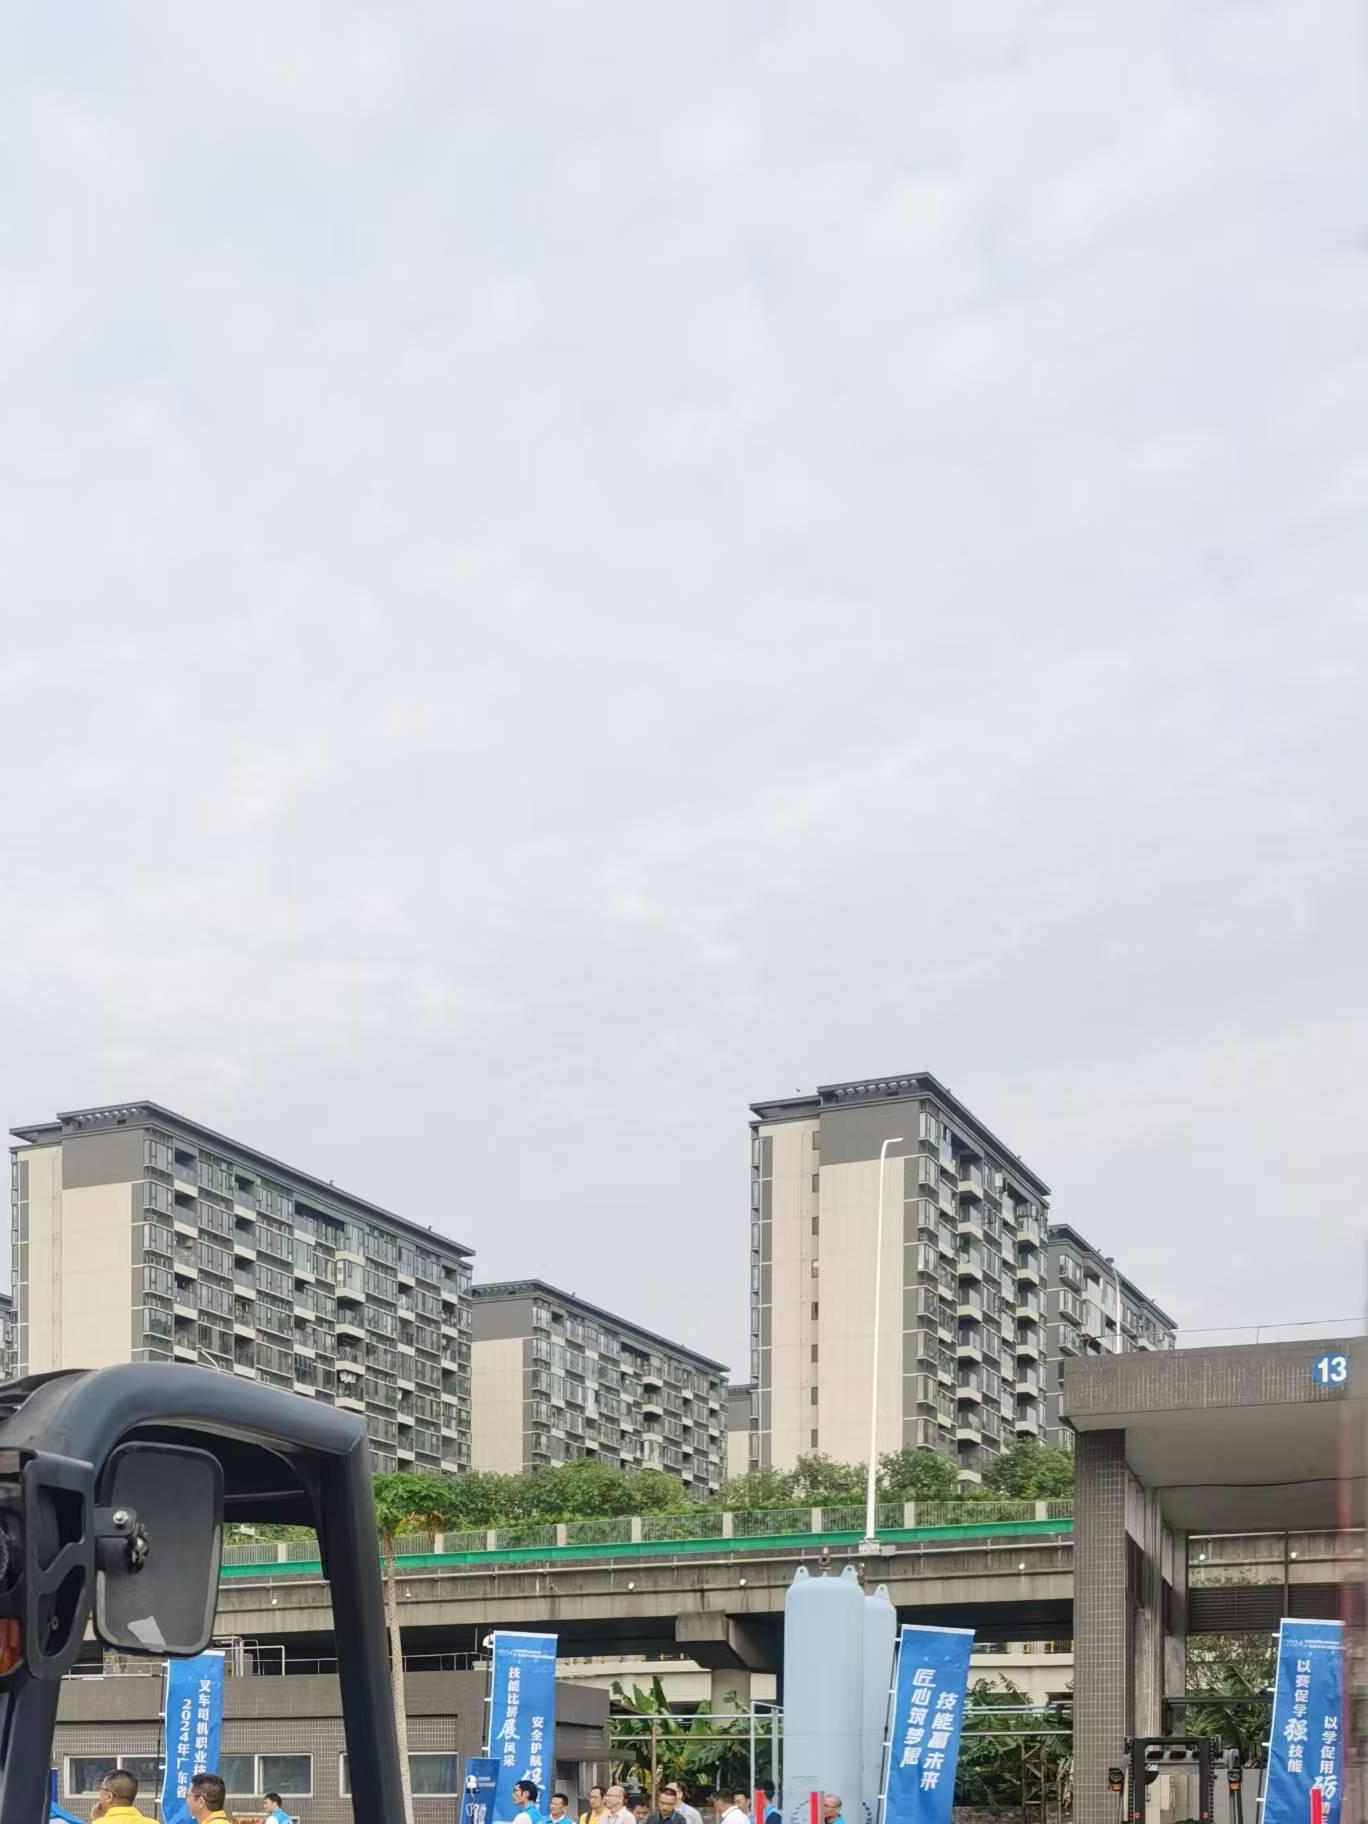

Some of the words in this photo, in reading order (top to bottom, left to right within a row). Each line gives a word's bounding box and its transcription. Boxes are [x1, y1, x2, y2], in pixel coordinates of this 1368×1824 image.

[1317, 1356, 1347, 1383] 13
[176, 1698, 192, 1799] 2024年广东省
[920, 1691, 958, 1792] 技能赢未来
